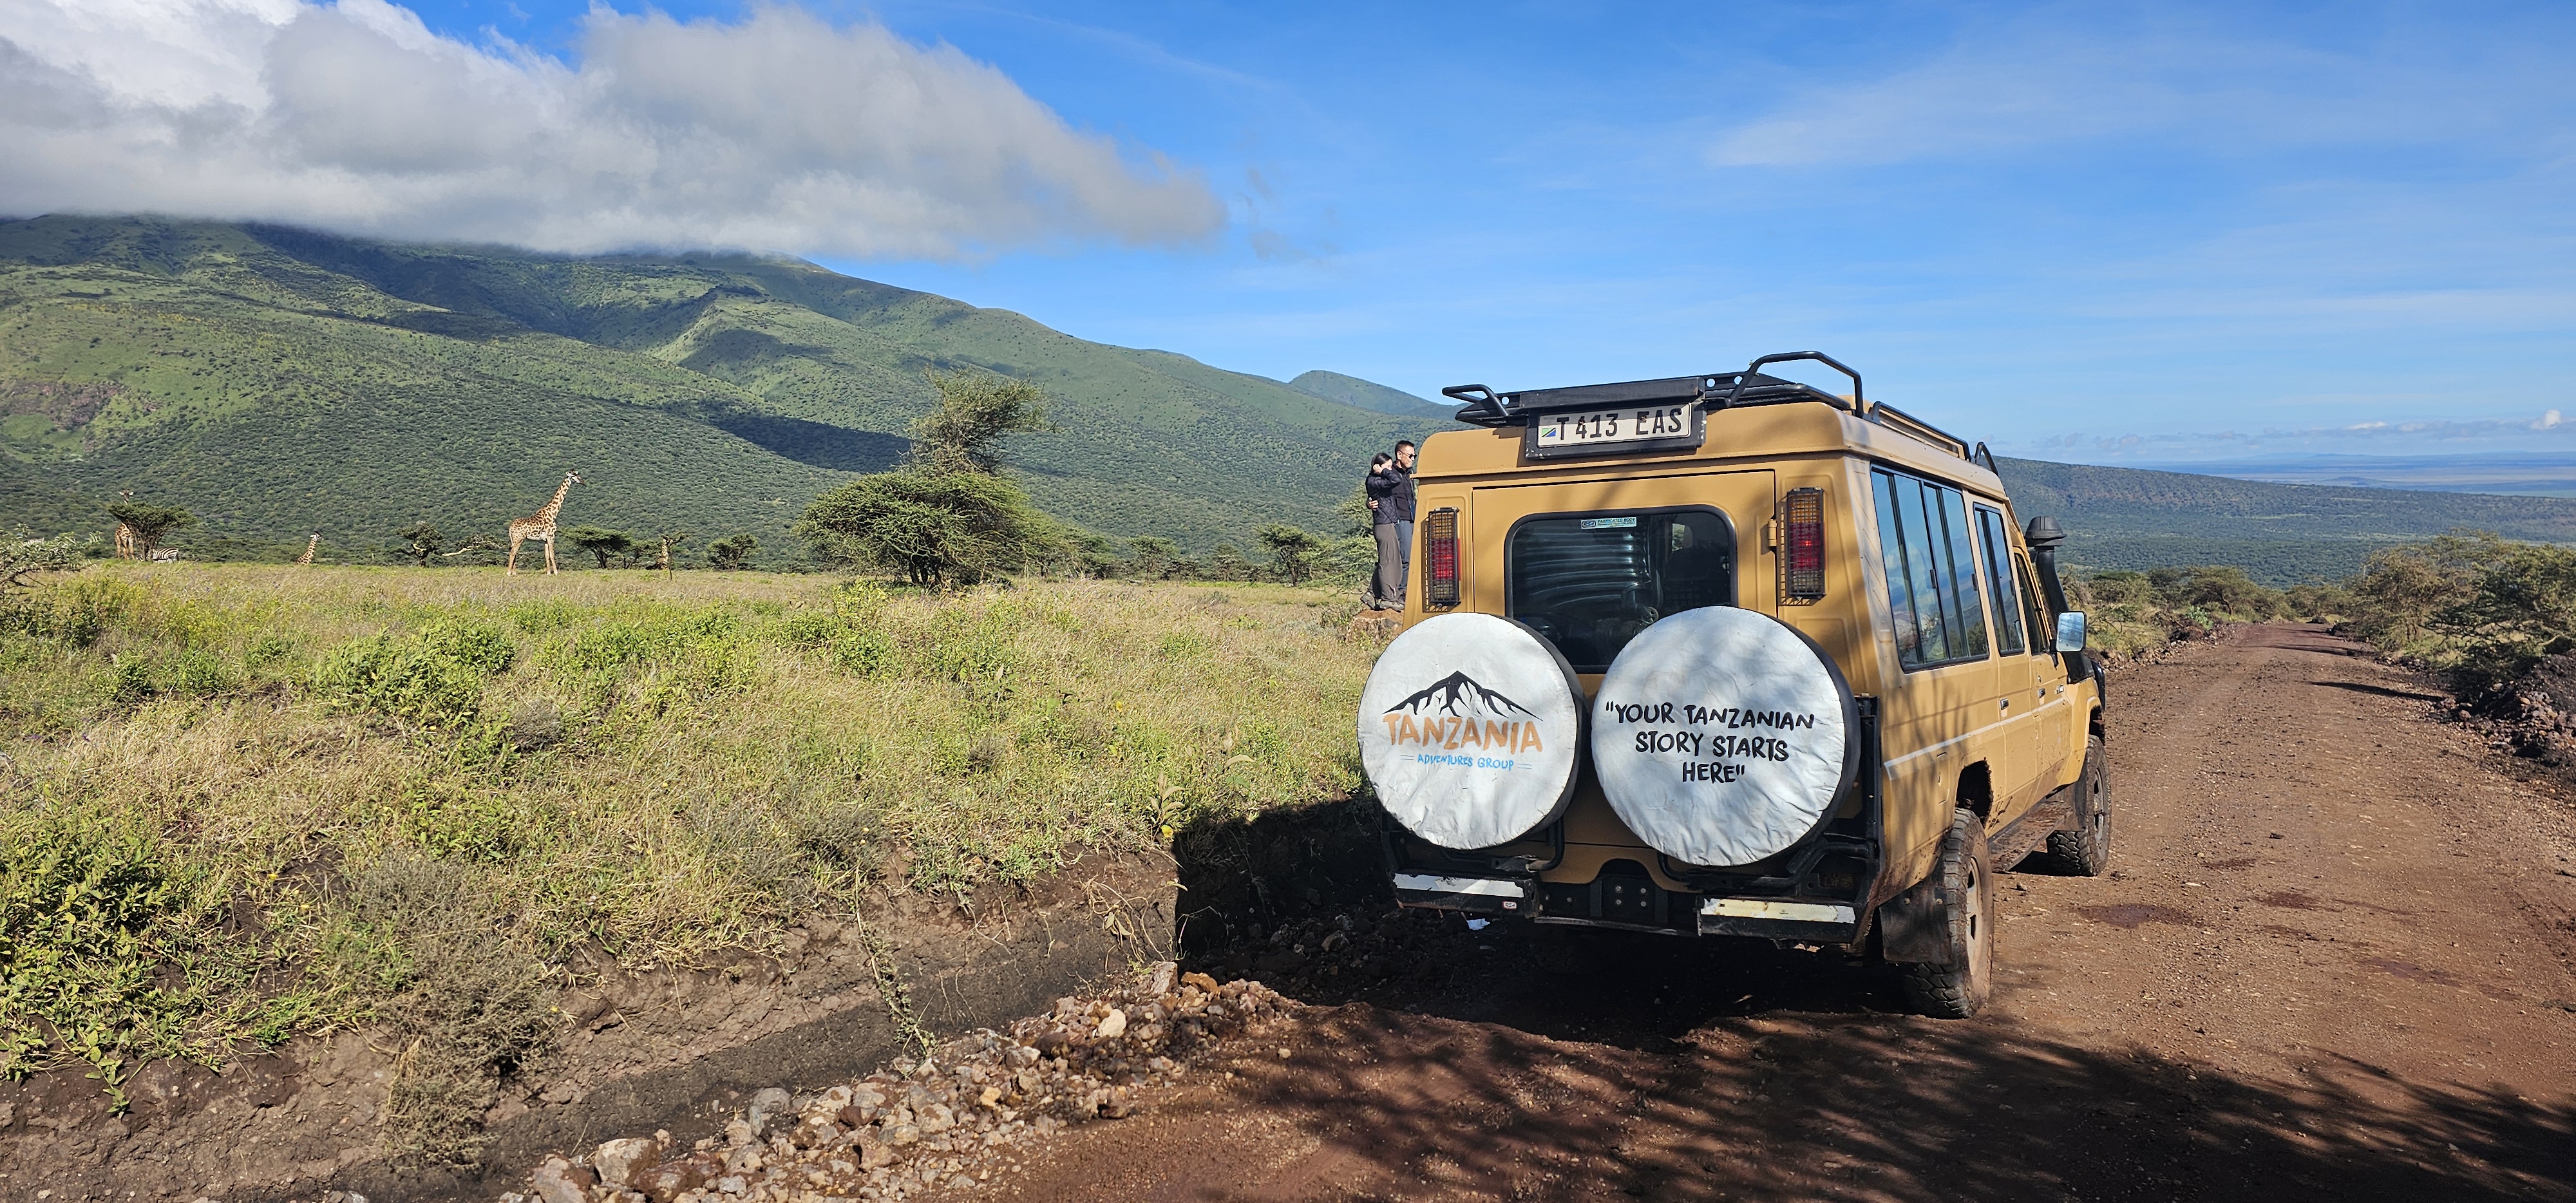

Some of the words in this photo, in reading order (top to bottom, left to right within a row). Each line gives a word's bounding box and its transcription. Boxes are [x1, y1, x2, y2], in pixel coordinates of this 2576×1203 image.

[1557, 417, 1569, 440] T
[1576, 413, 1618, 439] 413
[1636, 408, 1682, 435] EAS
[1605, 701, 1675, 724] "YOUR
[1683, 705, 1815, 731] TANZANIAN
[1383, 713, 1543, 755] TANZANIA
[1635, 730, 1704, 756] STORY
[1712, 735, 1790, 761] STARTS
[1417, 753, 1473, 767] ADVENTURES
[1477, 757, 1514, 771] GROUP
[1682, 761, 1745, 784] HERE"
